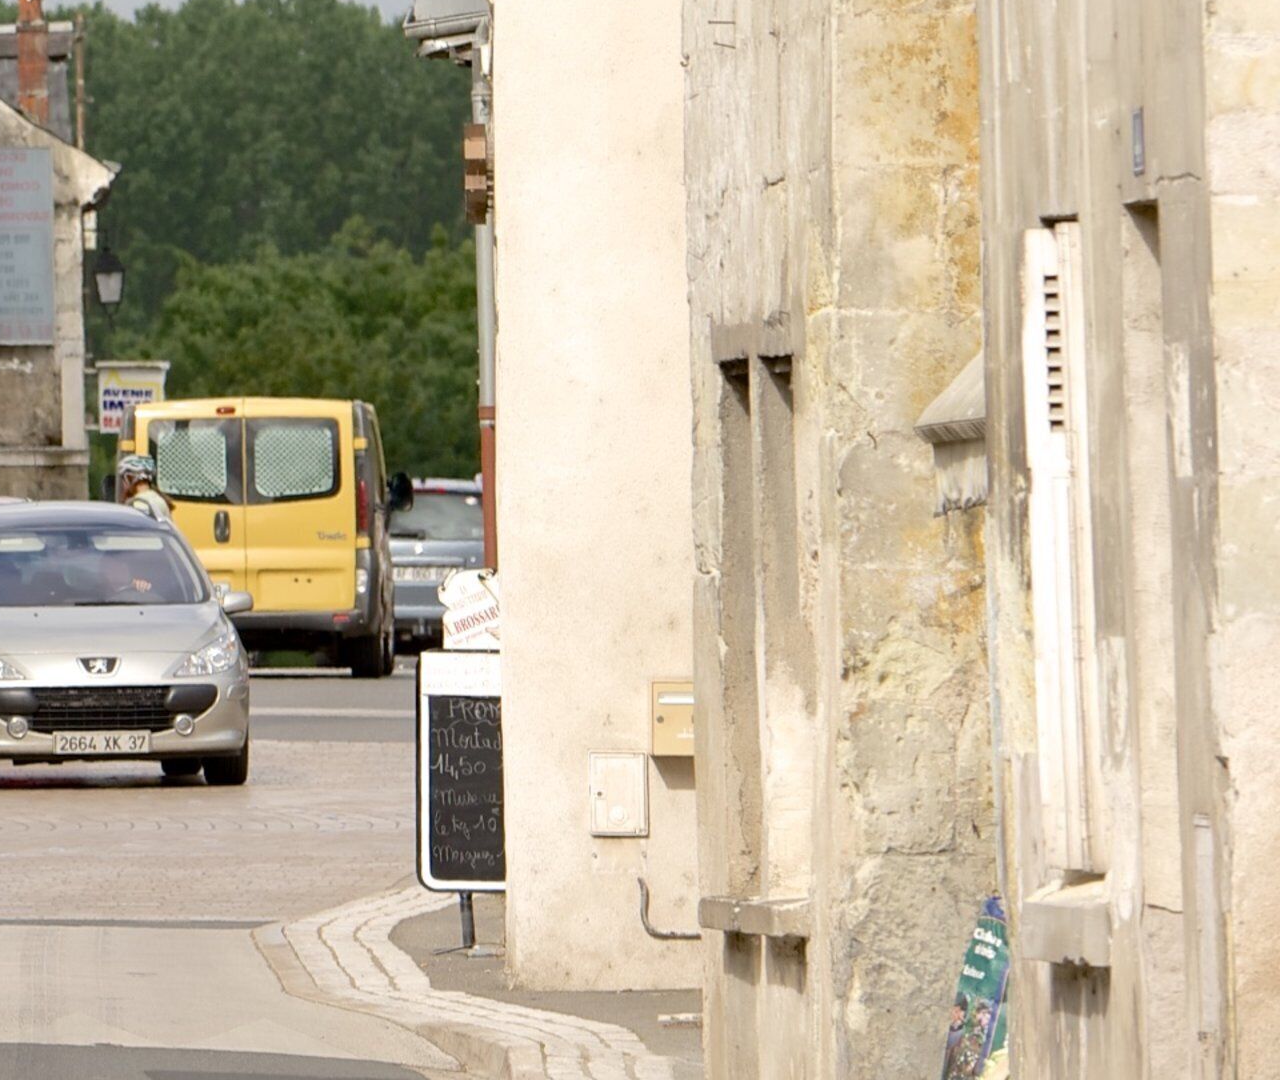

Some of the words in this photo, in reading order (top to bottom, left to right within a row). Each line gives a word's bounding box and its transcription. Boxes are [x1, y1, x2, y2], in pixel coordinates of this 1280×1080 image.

[60, 735, 96, 751] 2664
[104, 736, 122, 751] XK
[128, 735, 146, 750] 37
